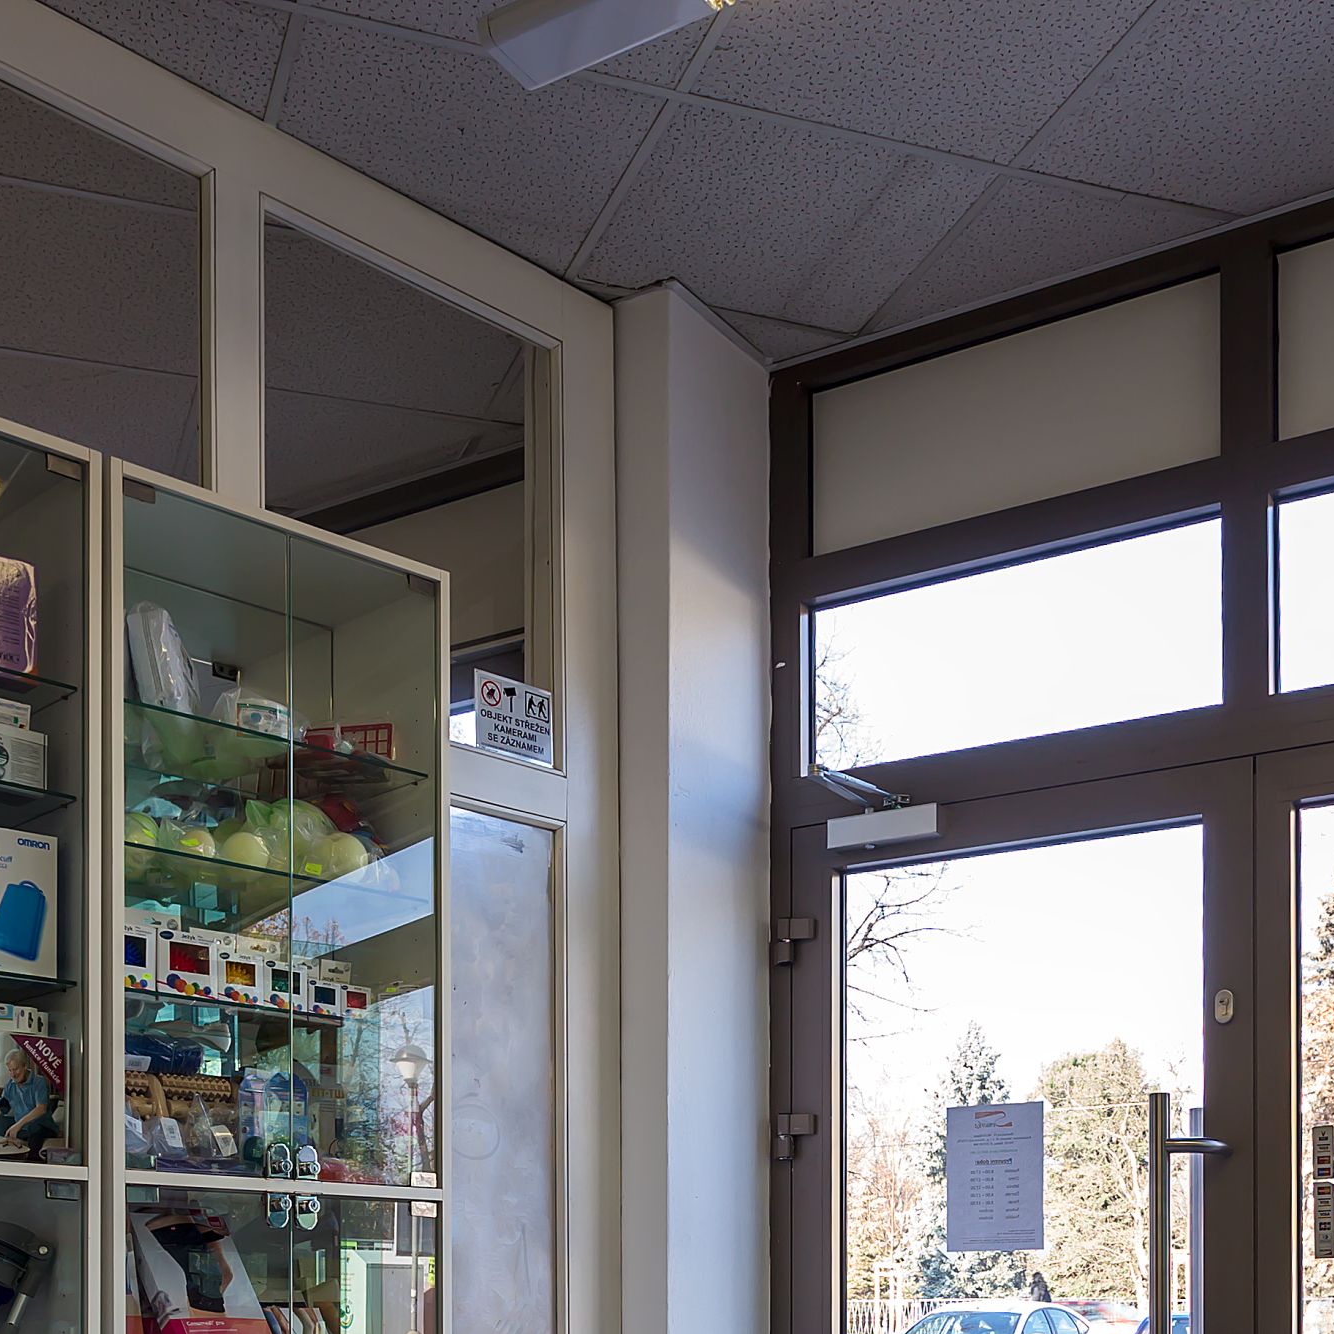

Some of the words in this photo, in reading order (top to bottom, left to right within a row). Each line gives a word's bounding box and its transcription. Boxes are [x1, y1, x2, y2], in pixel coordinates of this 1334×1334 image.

[480, 708, 513, 724] OBJEKT
[514, 718, 550, 736] STŘEŽEN
[493, 723, 537, 742] KAMERAMI
[487, 732, 499, 742] SE
[500, 734, 545, 756] ZÁZNAMEM
[17, 837, 50, 850] OMRON
[35, 1039, 63, 1069] NOVÉ
